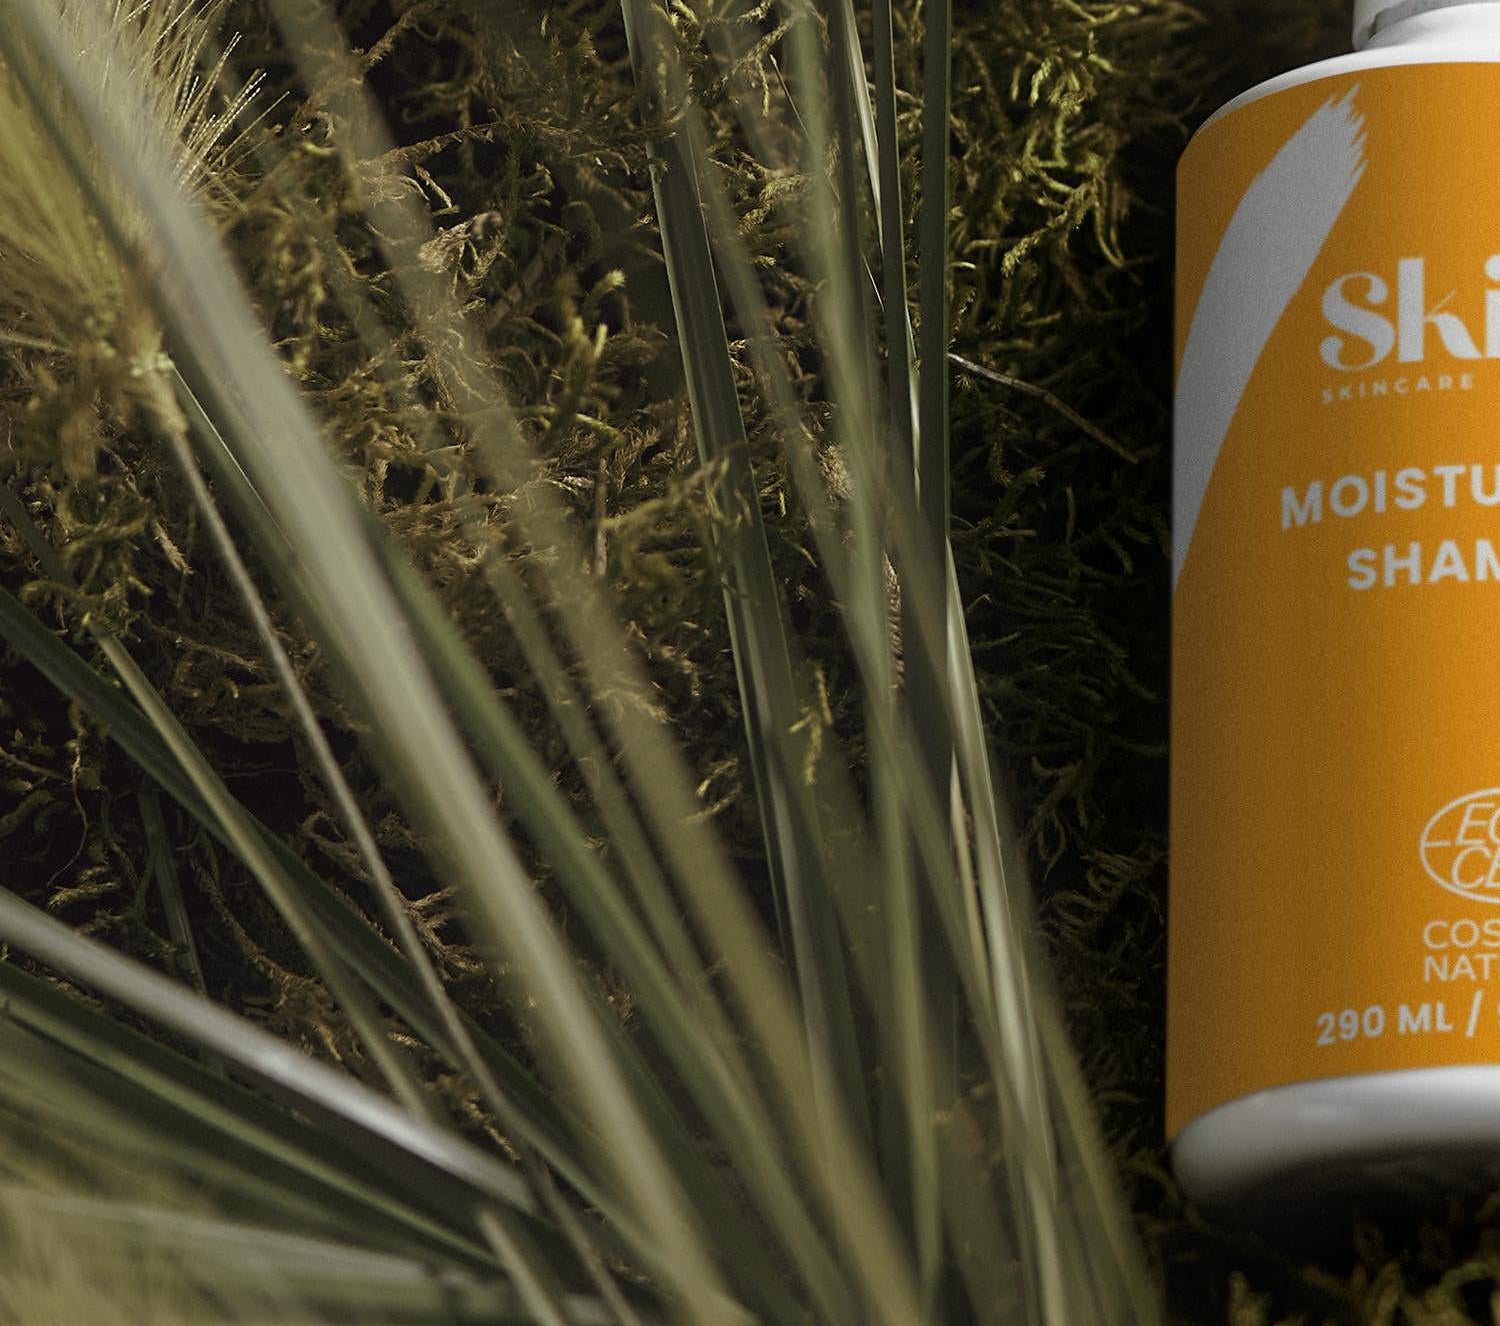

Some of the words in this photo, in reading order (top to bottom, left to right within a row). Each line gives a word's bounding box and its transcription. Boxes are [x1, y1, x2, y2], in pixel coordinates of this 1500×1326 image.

[1319, 373, 1475, 406] SKINCARE
[1316, 1004, 1386, 1047] 290
[1398, 1002, 1453, 1034] ML
[1465, 989, 1484, 1038] /
